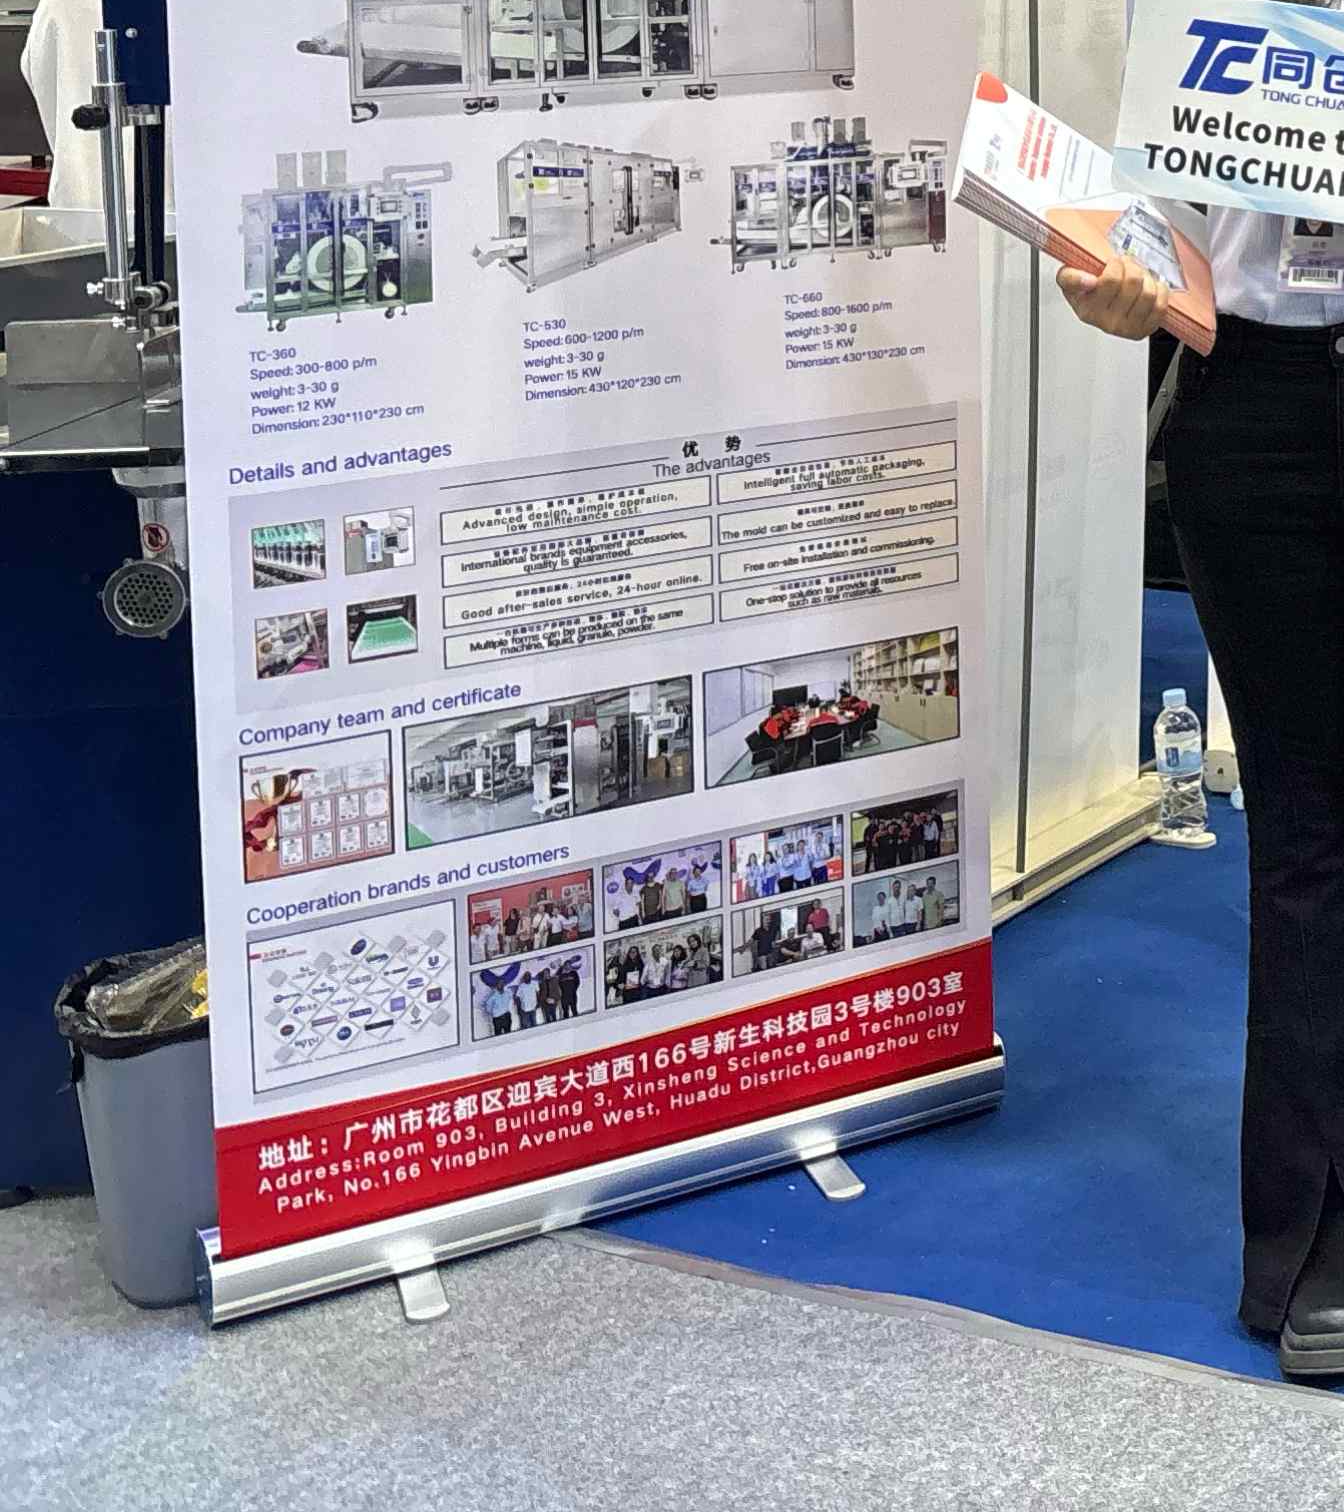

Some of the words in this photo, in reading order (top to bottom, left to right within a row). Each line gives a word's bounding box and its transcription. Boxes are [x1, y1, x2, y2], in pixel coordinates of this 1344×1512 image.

[1261, 89, 1301, 105] TONG
[1173, 106, 1327, 152] Welcome
[784, 307, 821, 321] Speed:
[823, 322, 846, 334] 3-30
[524, 337, 563, 352] Speed:
[837, 337, 854, 348] KW
[250, 348, 296, 362] TC-360
[567, 351, 593, 364] 3-30
[250, 366, 293, 380] Speed:
[296, 359, 349, 375] 300-800
[581, 366, 602, 378] KW
[250, 385, 295, 399] weight:
[297, 381, 327, 393] 3-30
[252, 404, 294, 416] Power:
[315, 398, 336, 409] KW
[252, 417, 320, 434] Dimension:
[406, 404, 424, 416] cm
[229, 463, 294, 485] Details
[302, 456, 337, 476] and
[344, 443, 452, 470] advantages
[654, 462, 680, 478] The
[685, 451, 770, 474] advantages
[463, 513, 523, 530] Advanced
[461, 608, 492, 620] Good
[238, 718, 330, 747] Company
[337, 702, 385, 727] team
[391, 696, 427, 717] and
[432, 682, 522, 712] certificate
[246, 888, 361, 925] Cooperation
[368, 873, 431, 900] brands
[437, 865, 471, 887] and
[477, 844, 570, 879] customers
[436, 1128, 485, 1149] 903,
[496, 1102, 583, 1133] Building
[594, 1093, 612, 1109] 3,
[623, 1066, 717, 1100] Xinsheng
[728, 1041, 807, 1073] Science
[815, 1028, 850, 1049] and
[860, 997, 966, 1035] Technology
[276, 1192, 334, 1214] Park,
[344, 1166, 421, 1197] No.166
[431, 1143, 509, 1172] Yingbin
[519, 1120, 593, 1150] Avenue
[604, 1104, 660, 1127] West,
[670, 1084, 731, 1110] Huadu
[927, 1021, 960, 1041] city
